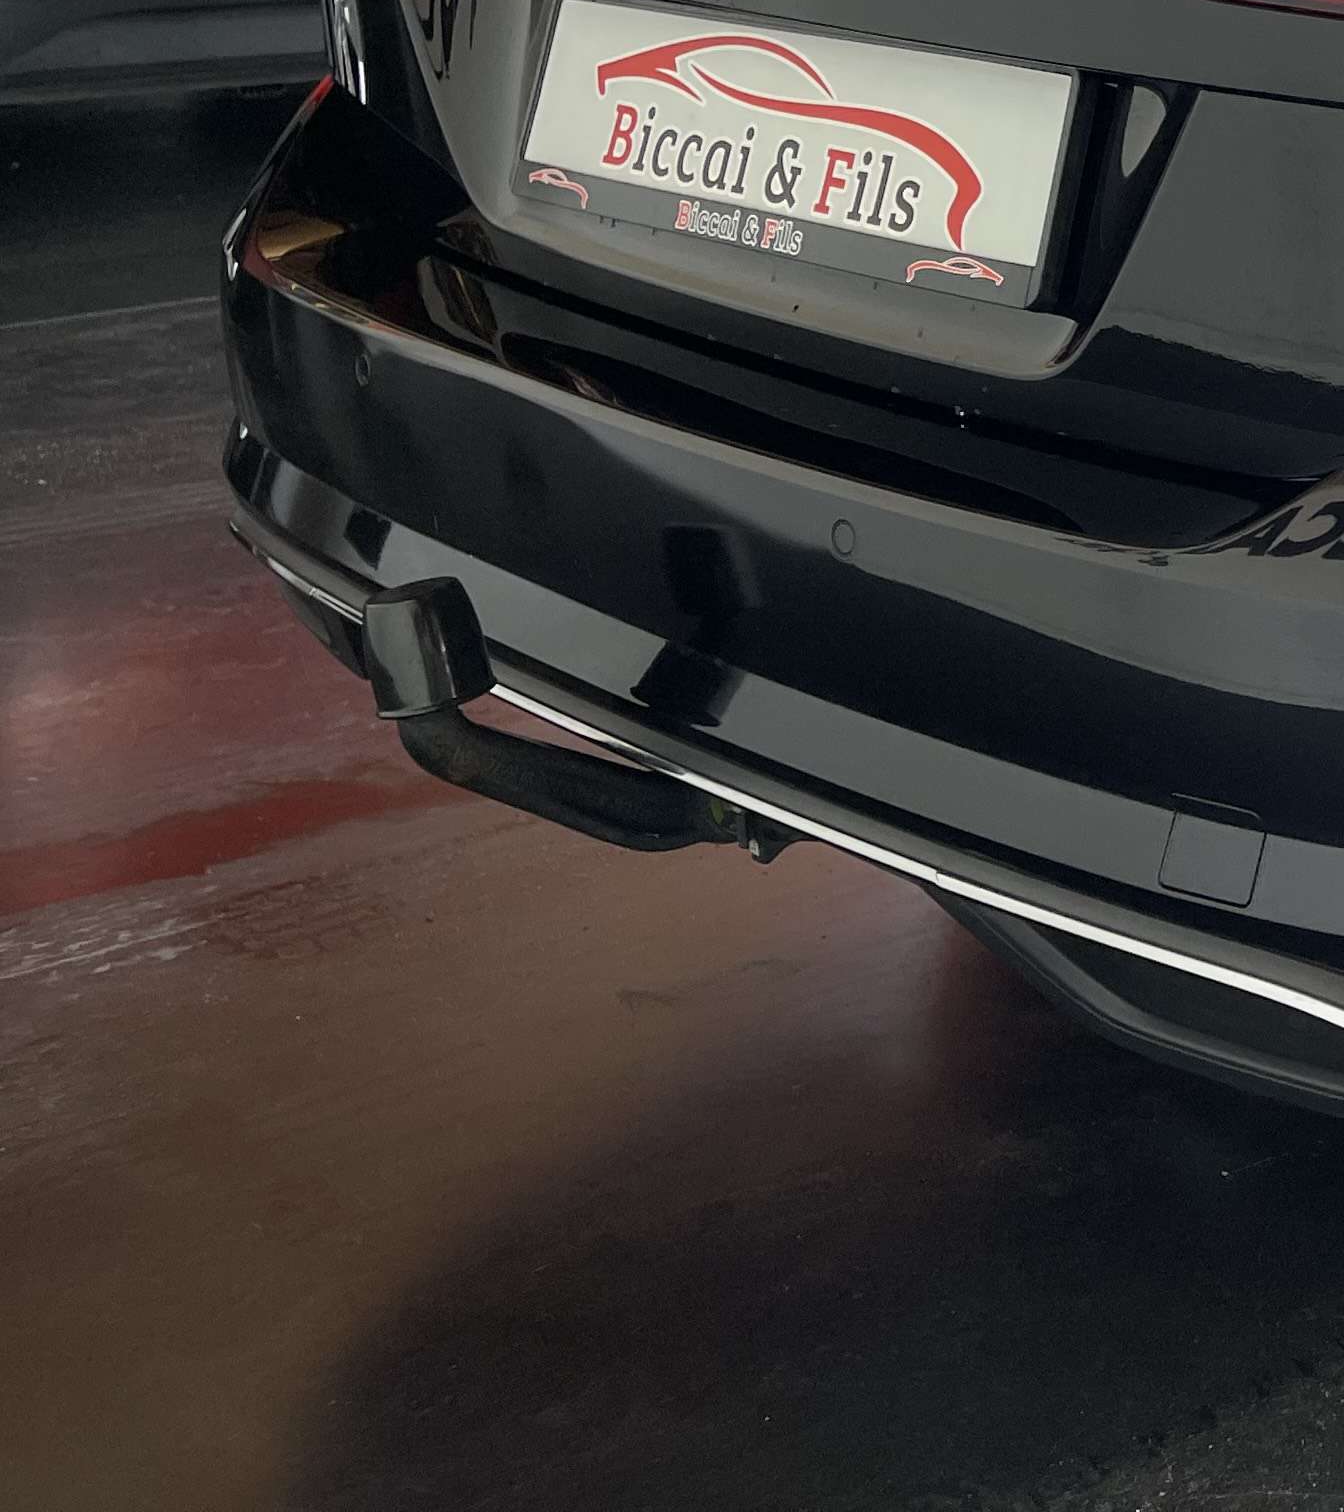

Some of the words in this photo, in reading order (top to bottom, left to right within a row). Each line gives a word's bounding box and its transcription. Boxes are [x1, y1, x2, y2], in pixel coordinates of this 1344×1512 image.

[602, 104, 757, 194] Biccai
[764, 138, 802, 208] &
[812, 147, 920, 233] Fils
[675, 200, 741, 241] Biccai
[741, 215, 760, 247] &
[760, 218, 803, 255] Fils
